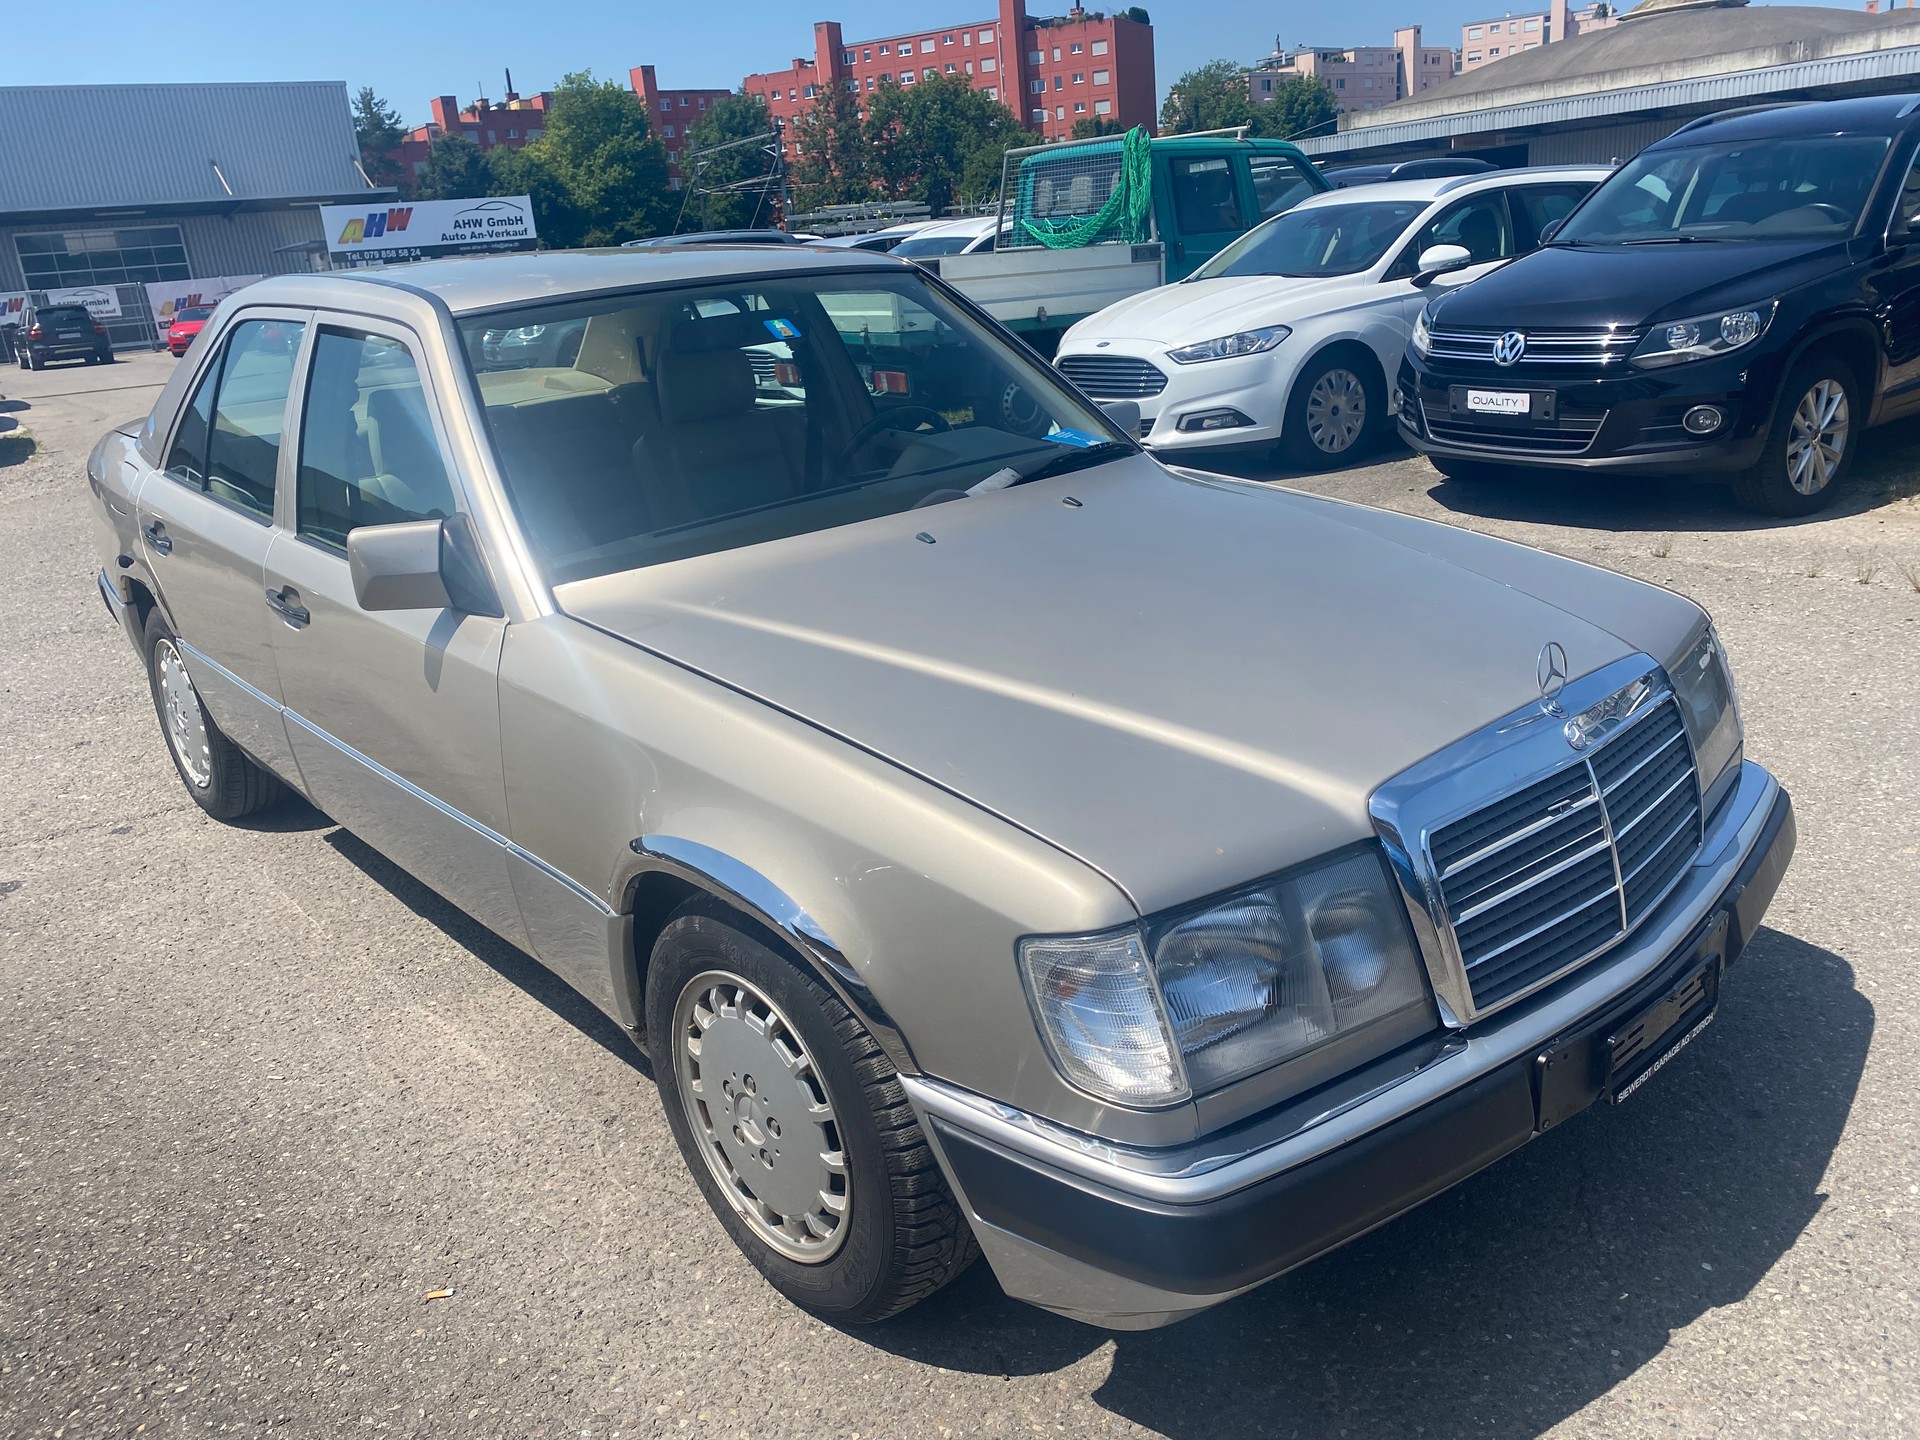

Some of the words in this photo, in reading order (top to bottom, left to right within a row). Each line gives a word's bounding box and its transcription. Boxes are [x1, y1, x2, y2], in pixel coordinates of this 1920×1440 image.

[338, 207, 413, 244] AHW
[453, 218, 483, 230] AHW
[487, 215, 524, 227] GmbH
[441, 232, 467, 242] Auto
[470, 227, 528, 240] An-Verkauf
[346, 252, 362, 261] Tel.
[364, 251, 380, 260] 079
[381, 250, 396, 258] 858
[398, 249, 409, 257] 58
[410, 248, 421, 256] 24
[81, 298, 110, 307] GmbH
[158, 293, 203, 316] AHW
[1472, 396, 1519, 407] QUALITY
[1618, 1067, 1652, 1103] SIEWERDT
[1653, 1042, 1681, 1072] GARAGE
[1680, 1034, 1690, 1048] AG
